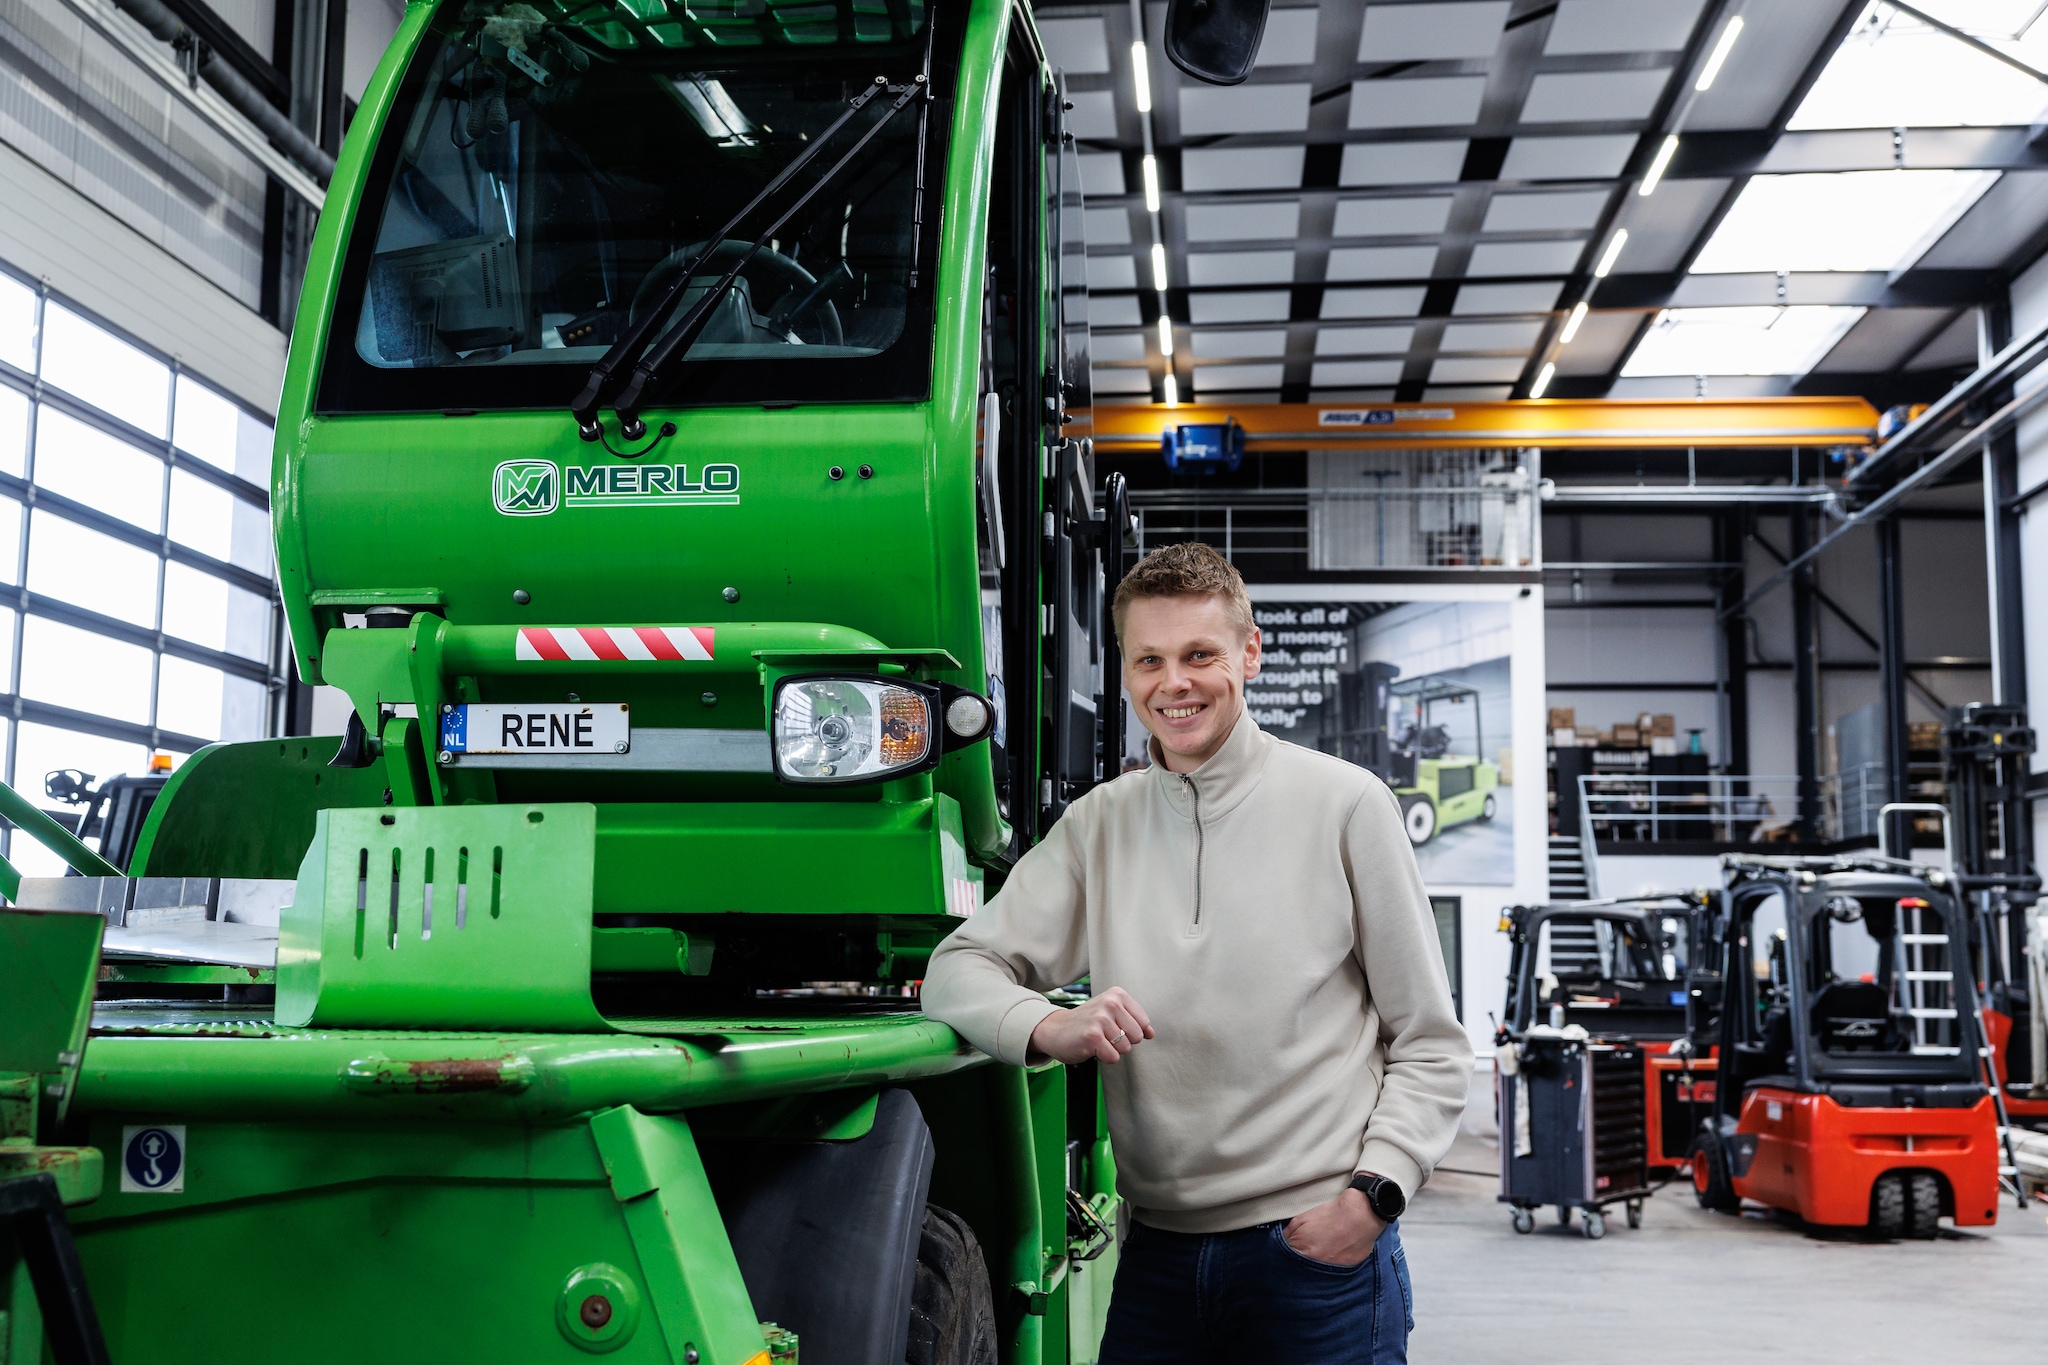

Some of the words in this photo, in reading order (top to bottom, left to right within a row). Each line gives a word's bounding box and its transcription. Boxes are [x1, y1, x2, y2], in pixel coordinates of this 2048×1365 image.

[566, 464, 740, 495] MERLO
[1255, 609, 1298, 624] took
[1301, 608, 1325, 625] all
[1328, 608, 1348, 624] of
[1261, 630, 1274, 645] is
[1278, 631, 1348, 646] money.
[1261, 650, 1296, 666] eah,
[1300, 648, 1337, 664] and
[1323, 669, 1338, 684] it
[1246, 689, 1299, 704] home
[1301, 690, 1322, 704] to
[501, 707, 594, 748] RENÉ
[444, 733, 465, 746] NL
